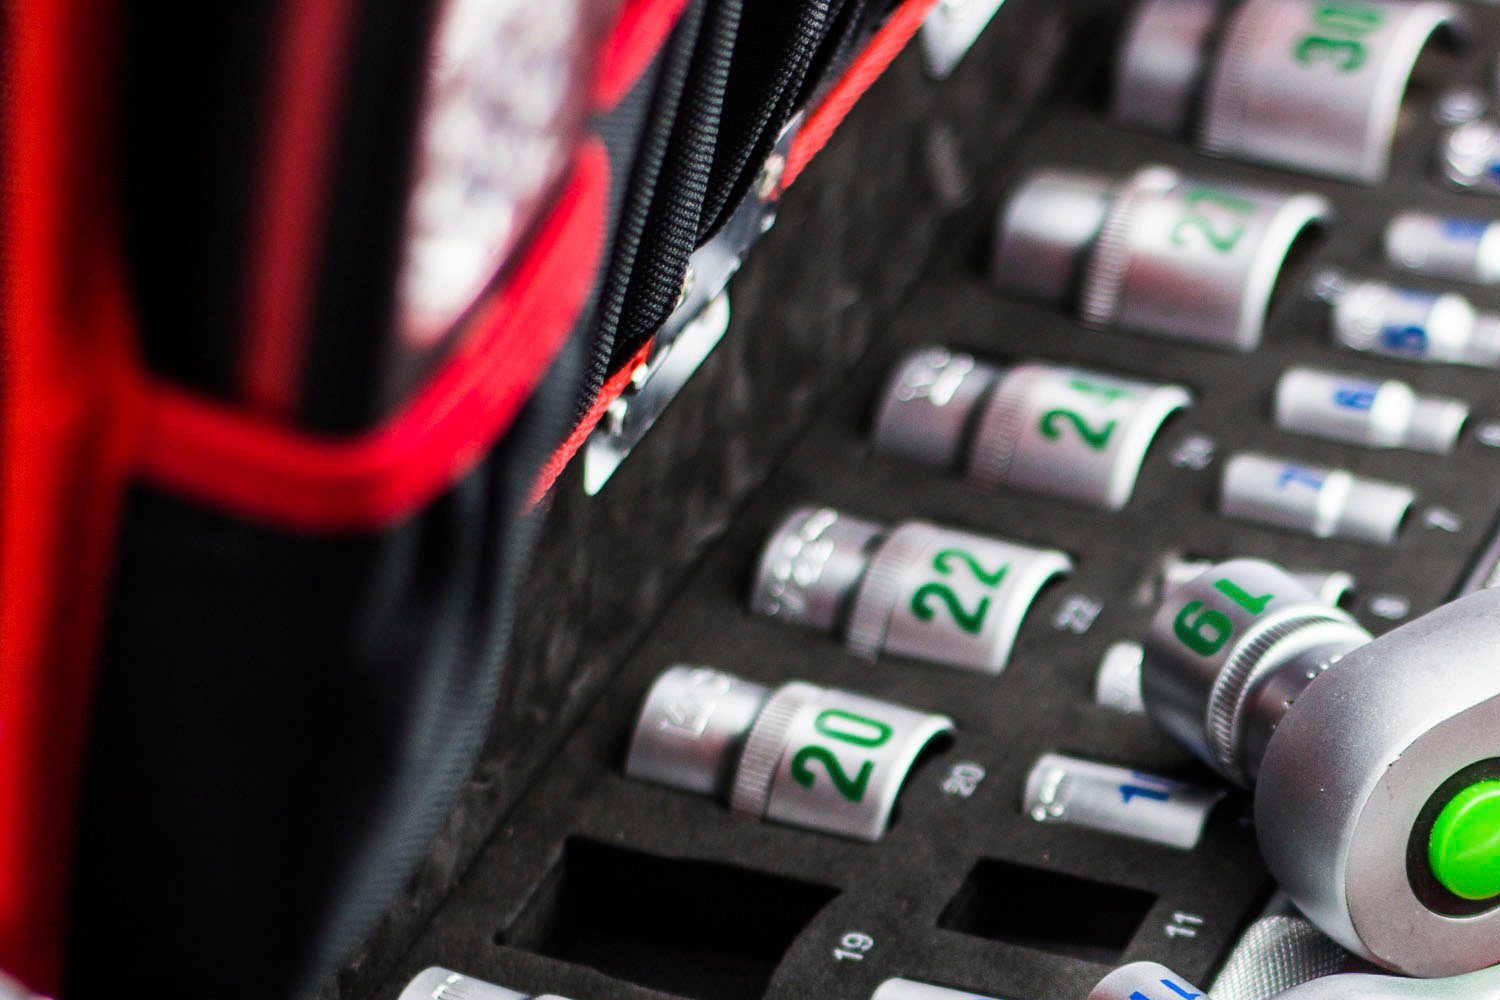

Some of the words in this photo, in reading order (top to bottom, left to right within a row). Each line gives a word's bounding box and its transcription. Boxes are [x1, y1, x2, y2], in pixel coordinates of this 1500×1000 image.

[909, 547, 1012, 635] 22
[1172, 577, 1274, 657] 19
[790, 707, 894, 803] 20
[942, 763, 985, 798] 20
[833, 931, 875, 961] 19
[1165, 911, 1204, 938] 11
